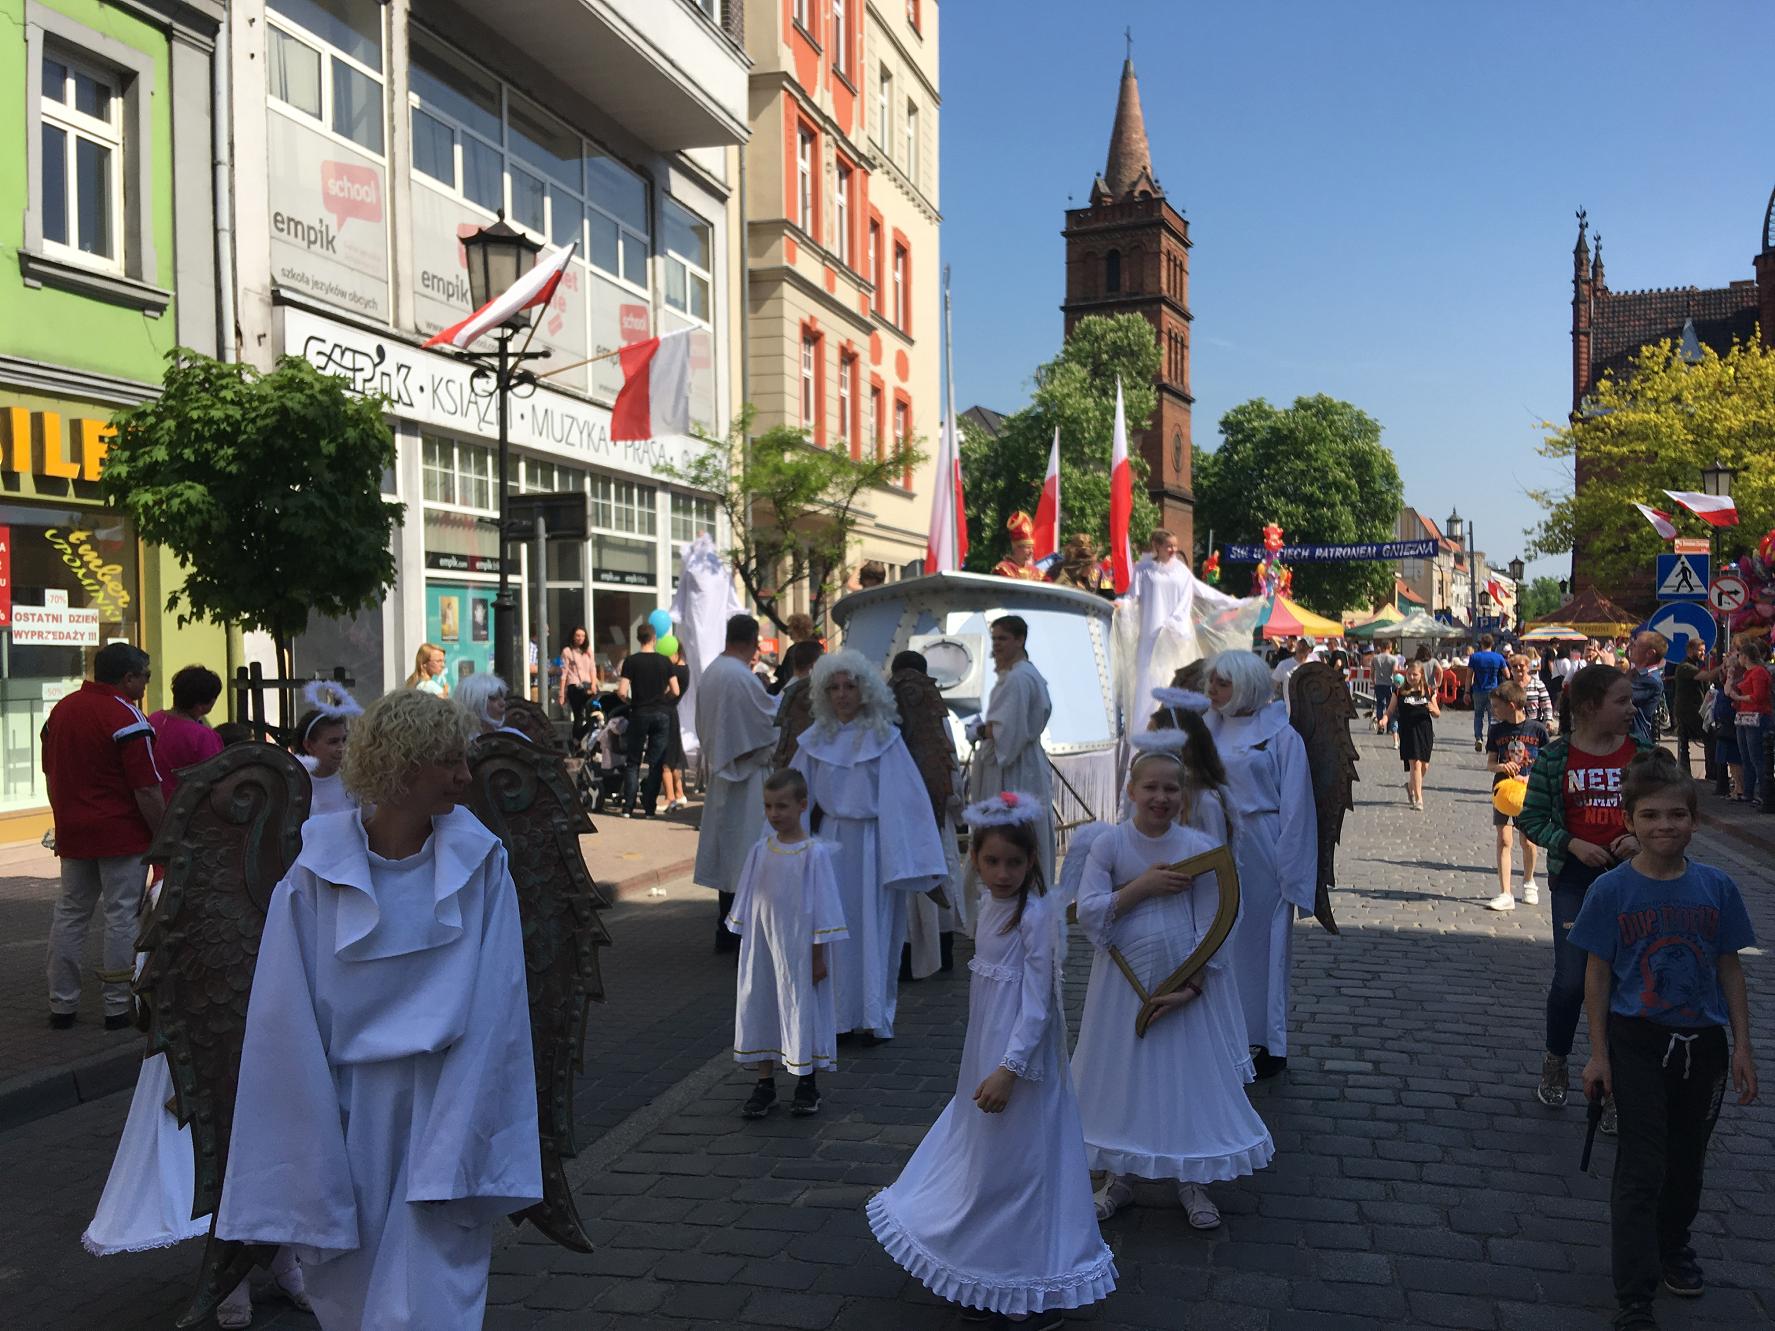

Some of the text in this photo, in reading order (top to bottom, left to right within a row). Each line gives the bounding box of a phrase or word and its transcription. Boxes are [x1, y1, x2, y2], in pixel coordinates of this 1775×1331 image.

[327, 176, 376, 204] school
[272, 211, 337, 254] empik
[421, 270, 469, 305] empik
[531, 404, 610, 456] MUZYKA
[624, 440, 668, 466] PRASA
[1314, 546, 1376, 560] PATRONEM
[1382, 541, 1434, 557] GNIEZNA
[14, 612, 98, 624] OSTATNI DZIEŃ
[13, 629, 86, 641] WYPRZEDAŻY
